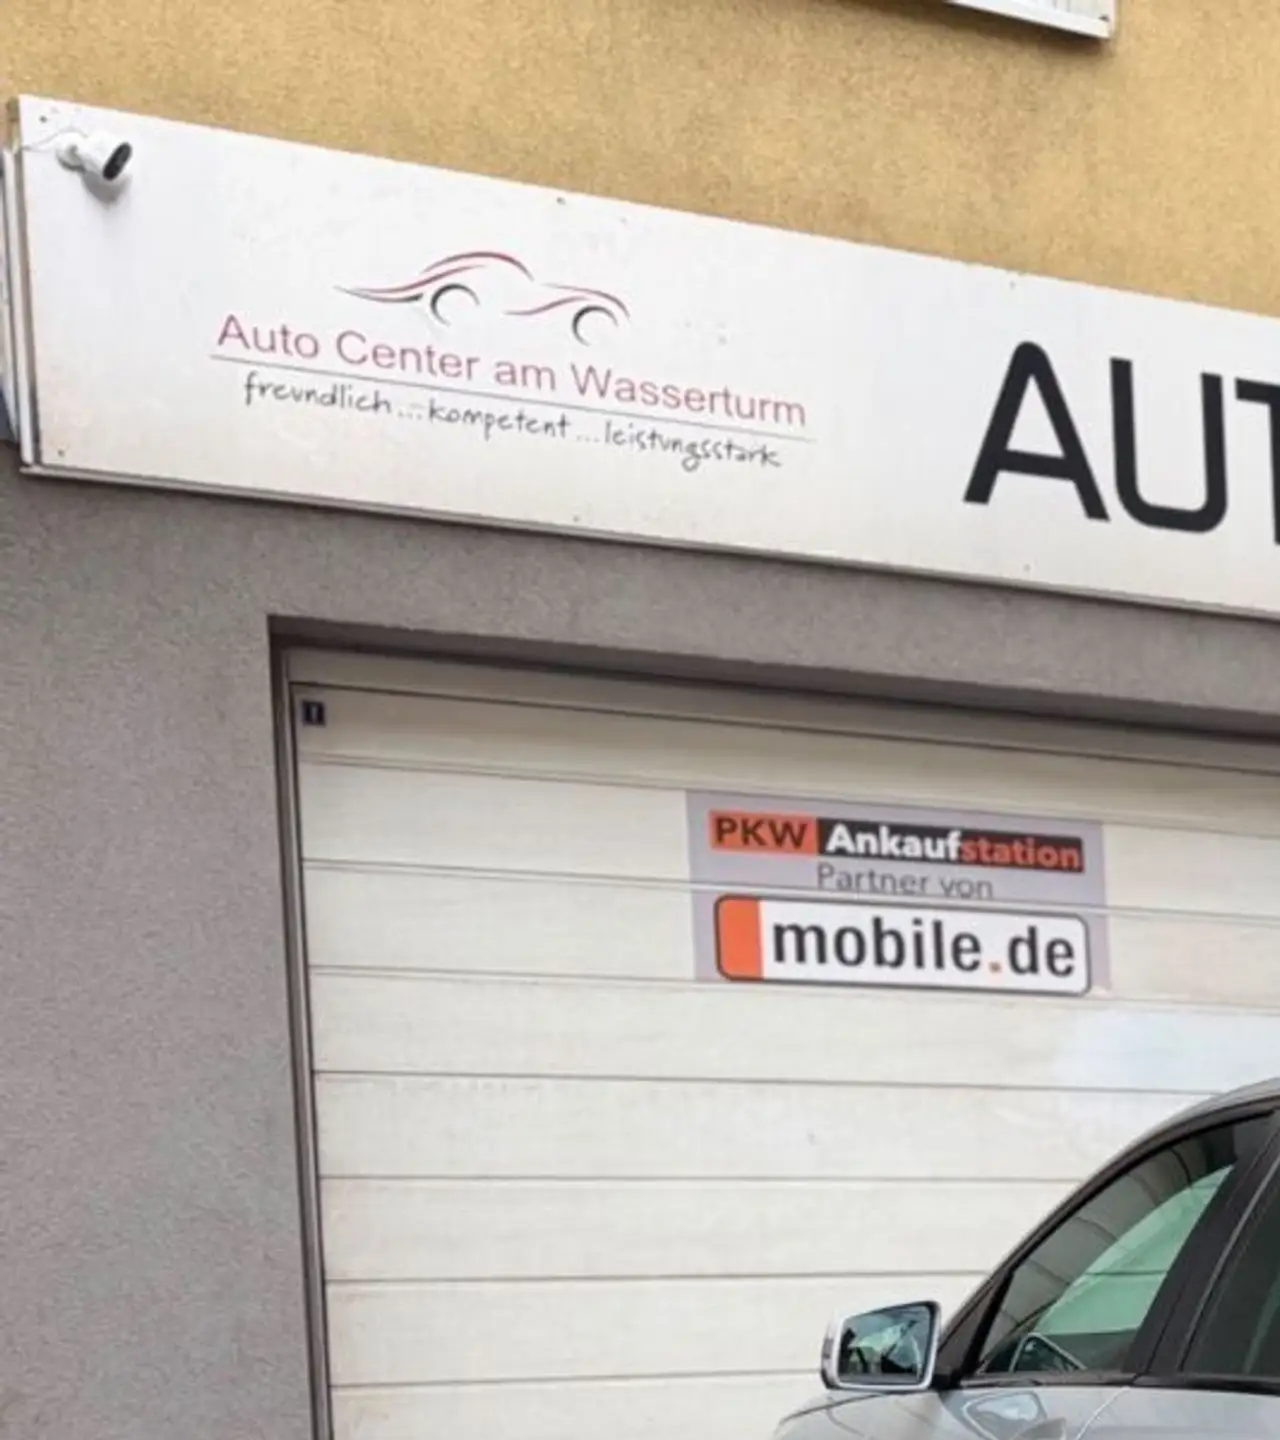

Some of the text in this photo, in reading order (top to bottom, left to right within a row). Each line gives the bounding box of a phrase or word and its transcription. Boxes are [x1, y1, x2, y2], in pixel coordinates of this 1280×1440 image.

[216, 313, 806, 427] Auto Center am Wasserturm
[714, 817, 1084, 870] PKW Ankaufstation
[816, 863, 994, 899] Partner von
[772, 916, 1075, 977] mobile.de
